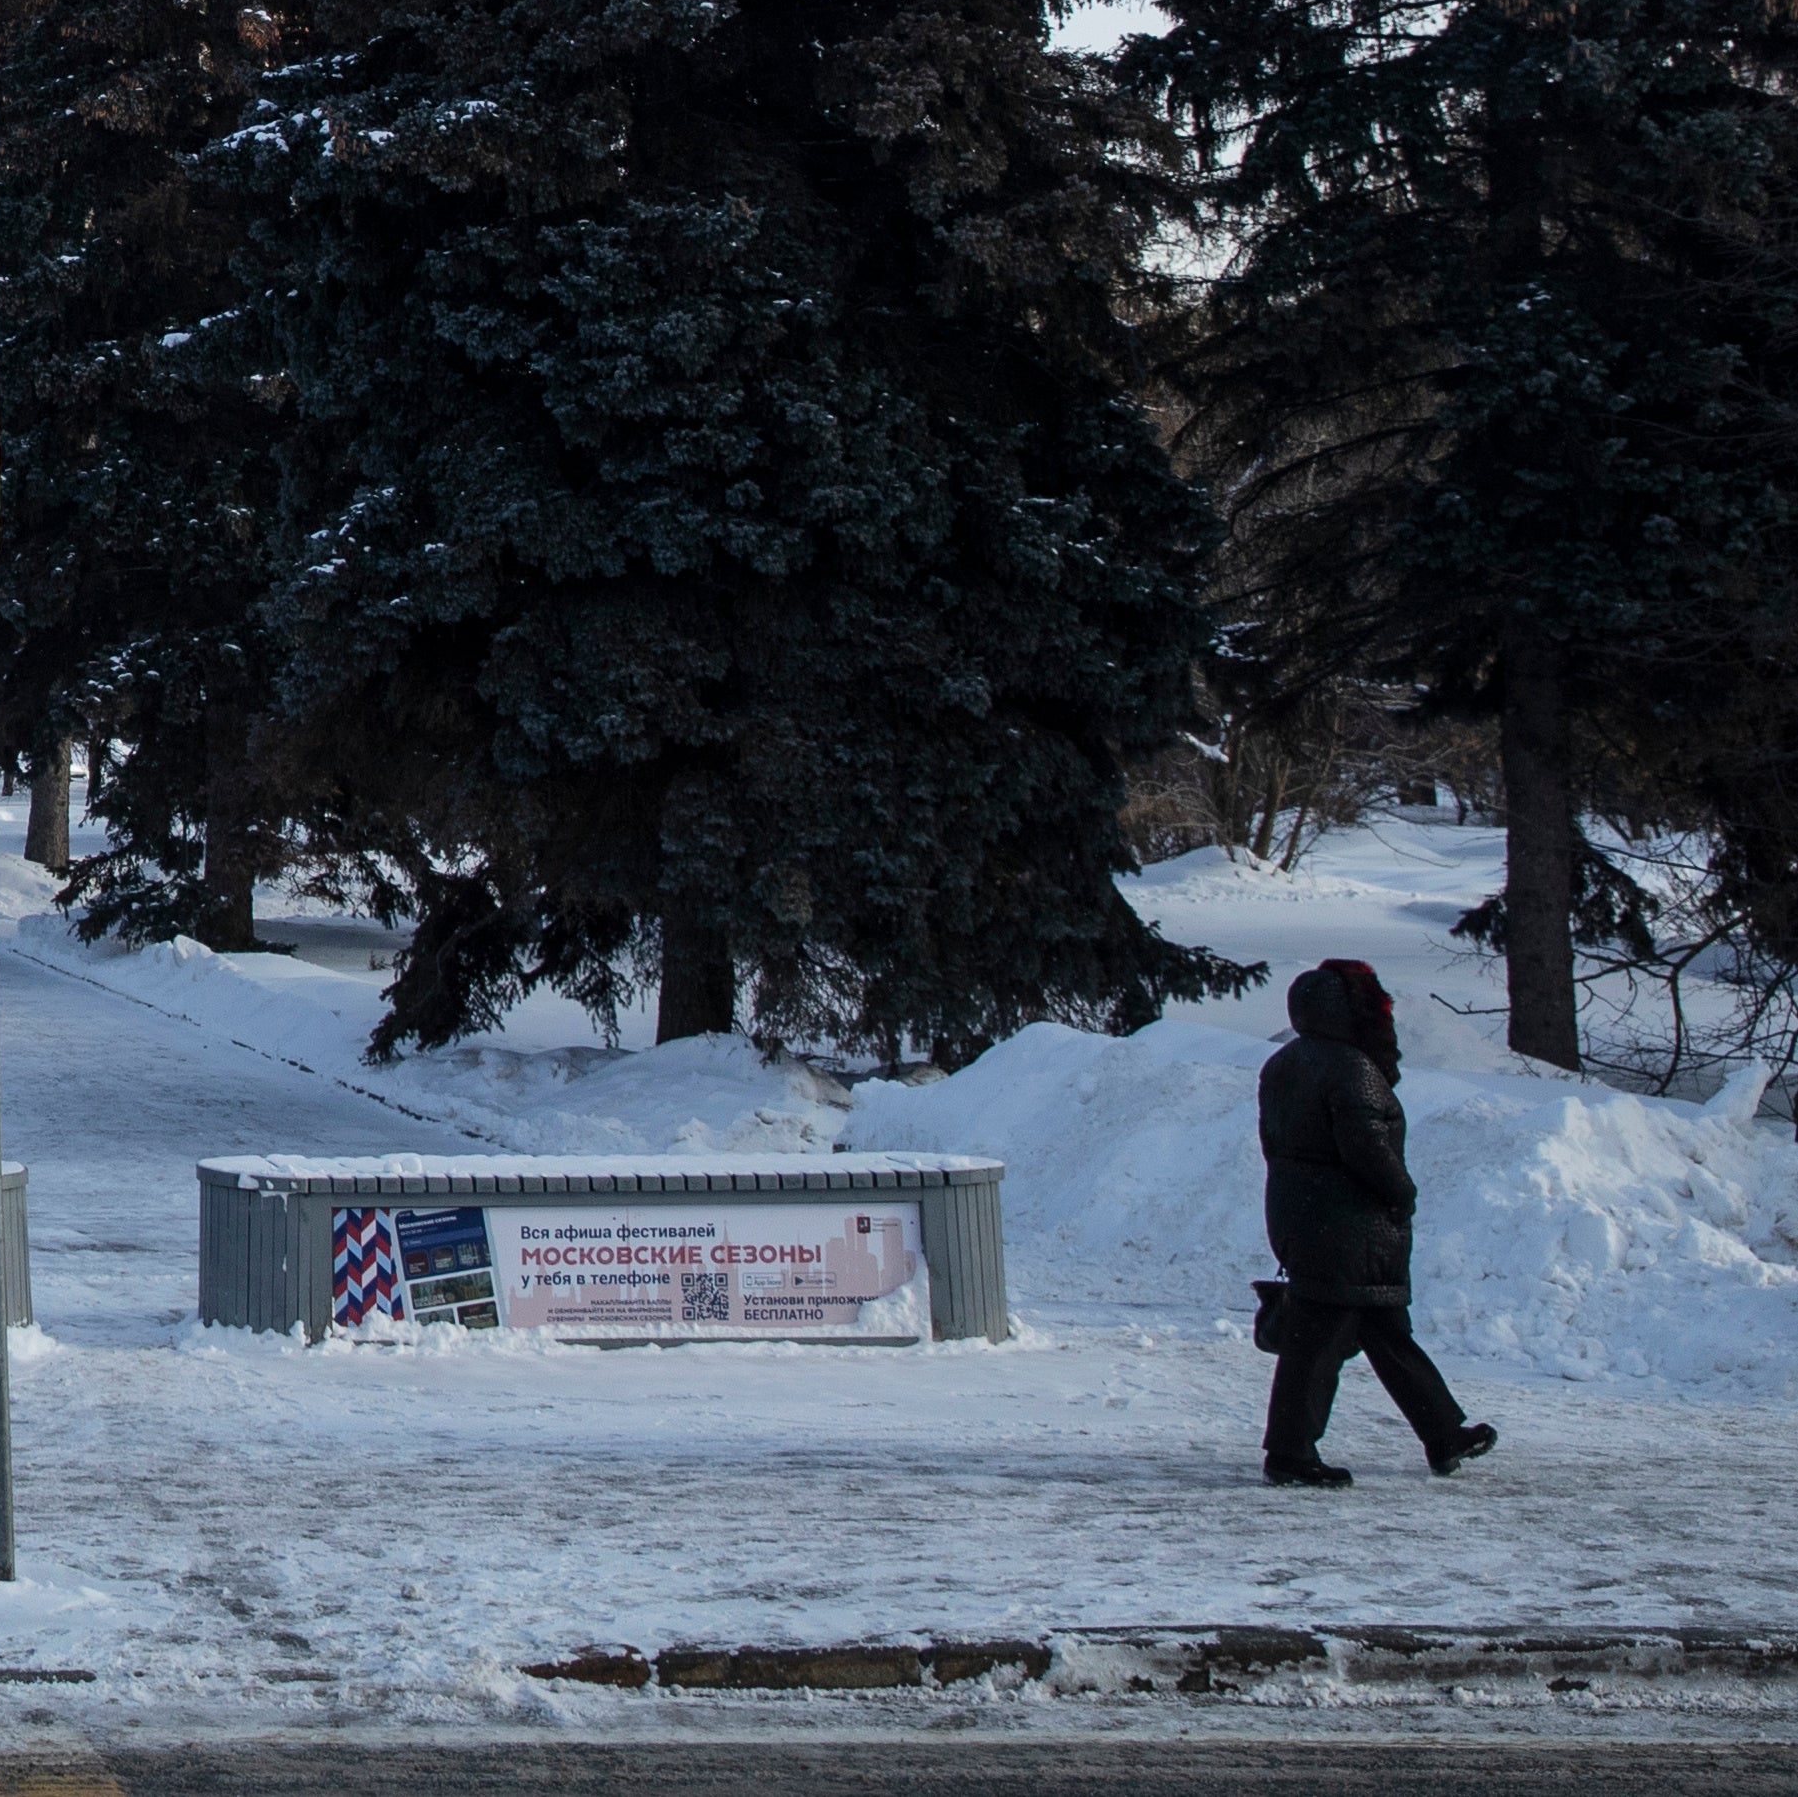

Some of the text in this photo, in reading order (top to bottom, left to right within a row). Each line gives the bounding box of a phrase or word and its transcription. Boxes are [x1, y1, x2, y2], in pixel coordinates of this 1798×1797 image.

[520, 1223, 716, 1242] Вся афиша фестивалей
[521, 1244, 822, 1266] МОСКОВСКИЕ СЕЗОНЫ
[521, 1270, 671, 1290] у тебя в телефоне
[744, 1294, 805, 1306] Установи
[744, 1309, 824, 1321] БЕСПЛАТНО
